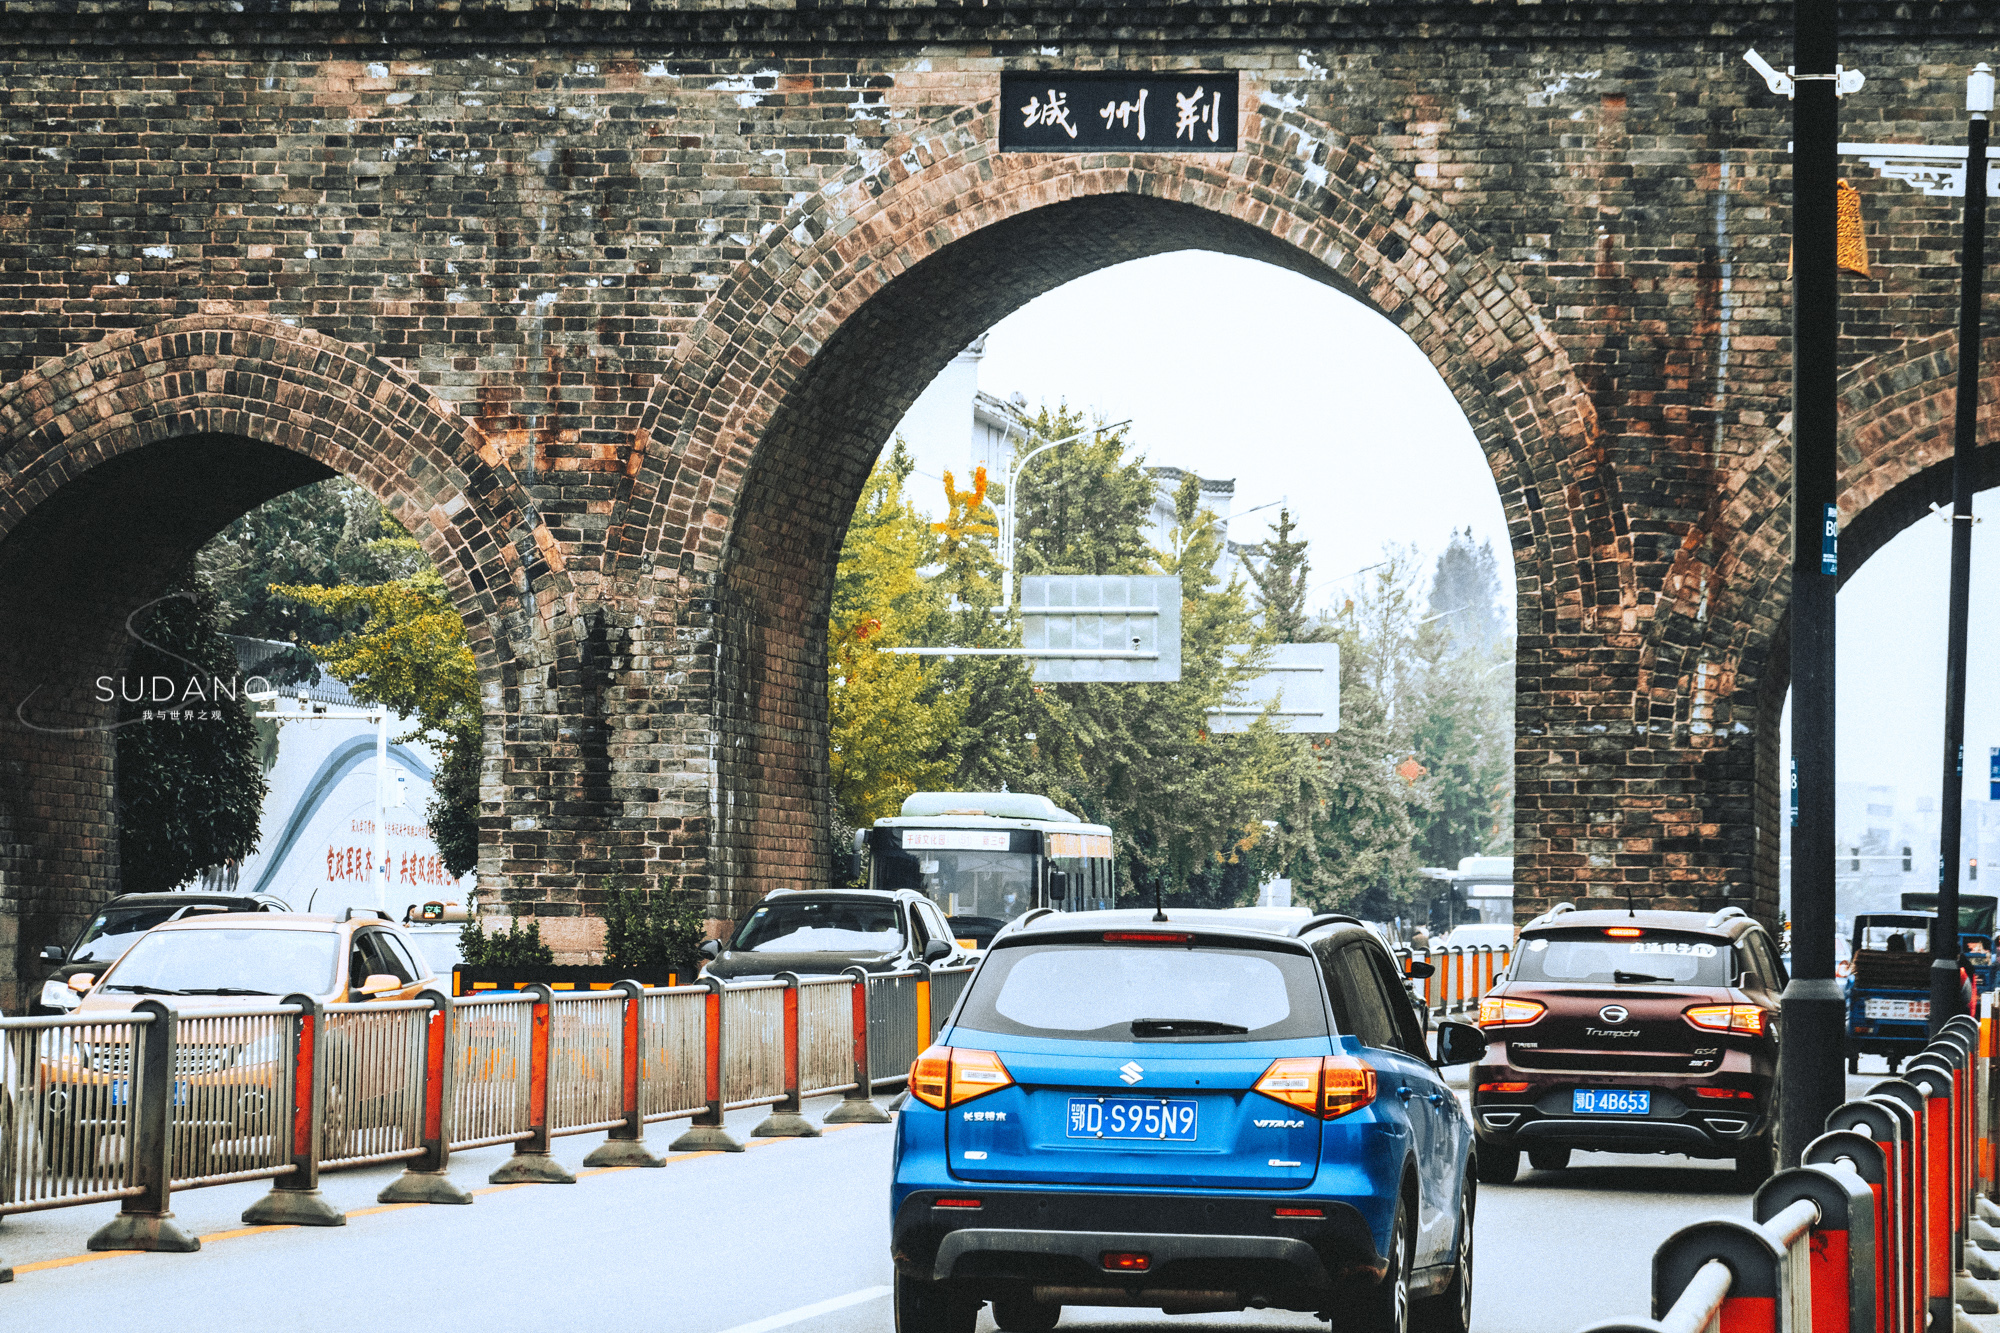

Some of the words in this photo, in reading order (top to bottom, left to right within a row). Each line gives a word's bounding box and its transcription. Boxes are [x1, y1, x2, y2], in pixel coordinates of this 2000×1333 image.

[1585, 1027, 1641, 1038] Trumpchi
[1694, 1047, 1719, 1055] GS4
[1253, 1119, 1305, 1129] VITARA
